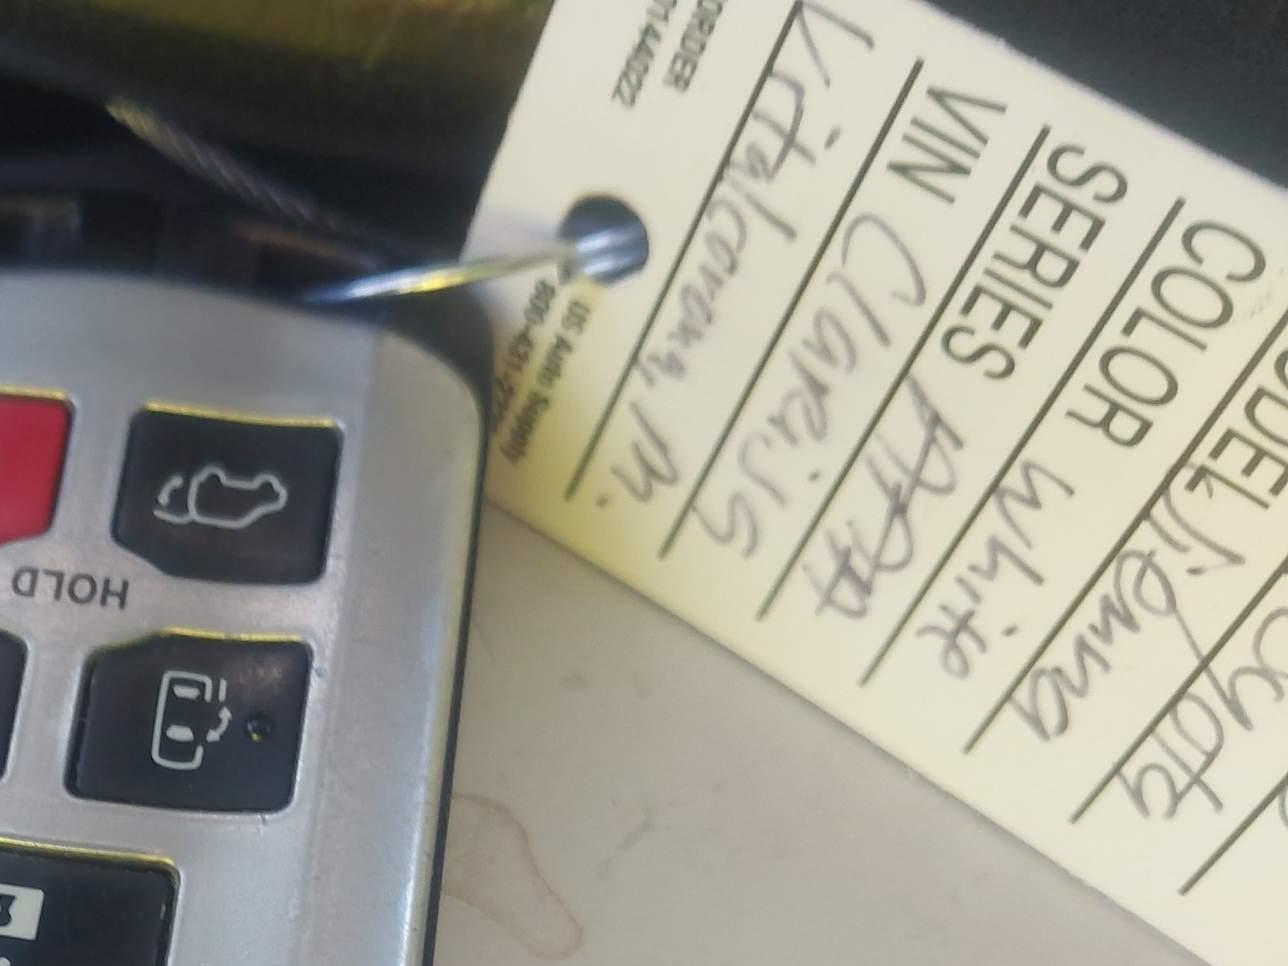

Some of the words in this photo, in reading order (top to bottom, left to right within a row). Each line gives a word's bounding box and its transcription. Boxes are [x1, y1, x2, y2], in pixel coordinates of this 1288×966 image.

[886, 86, 1008, 204] VIN
[939, 143, 1128, 382] SERIES
[1064, 219, 1267, 448] COLOR
[12, 566, 130, 610] HOLD
